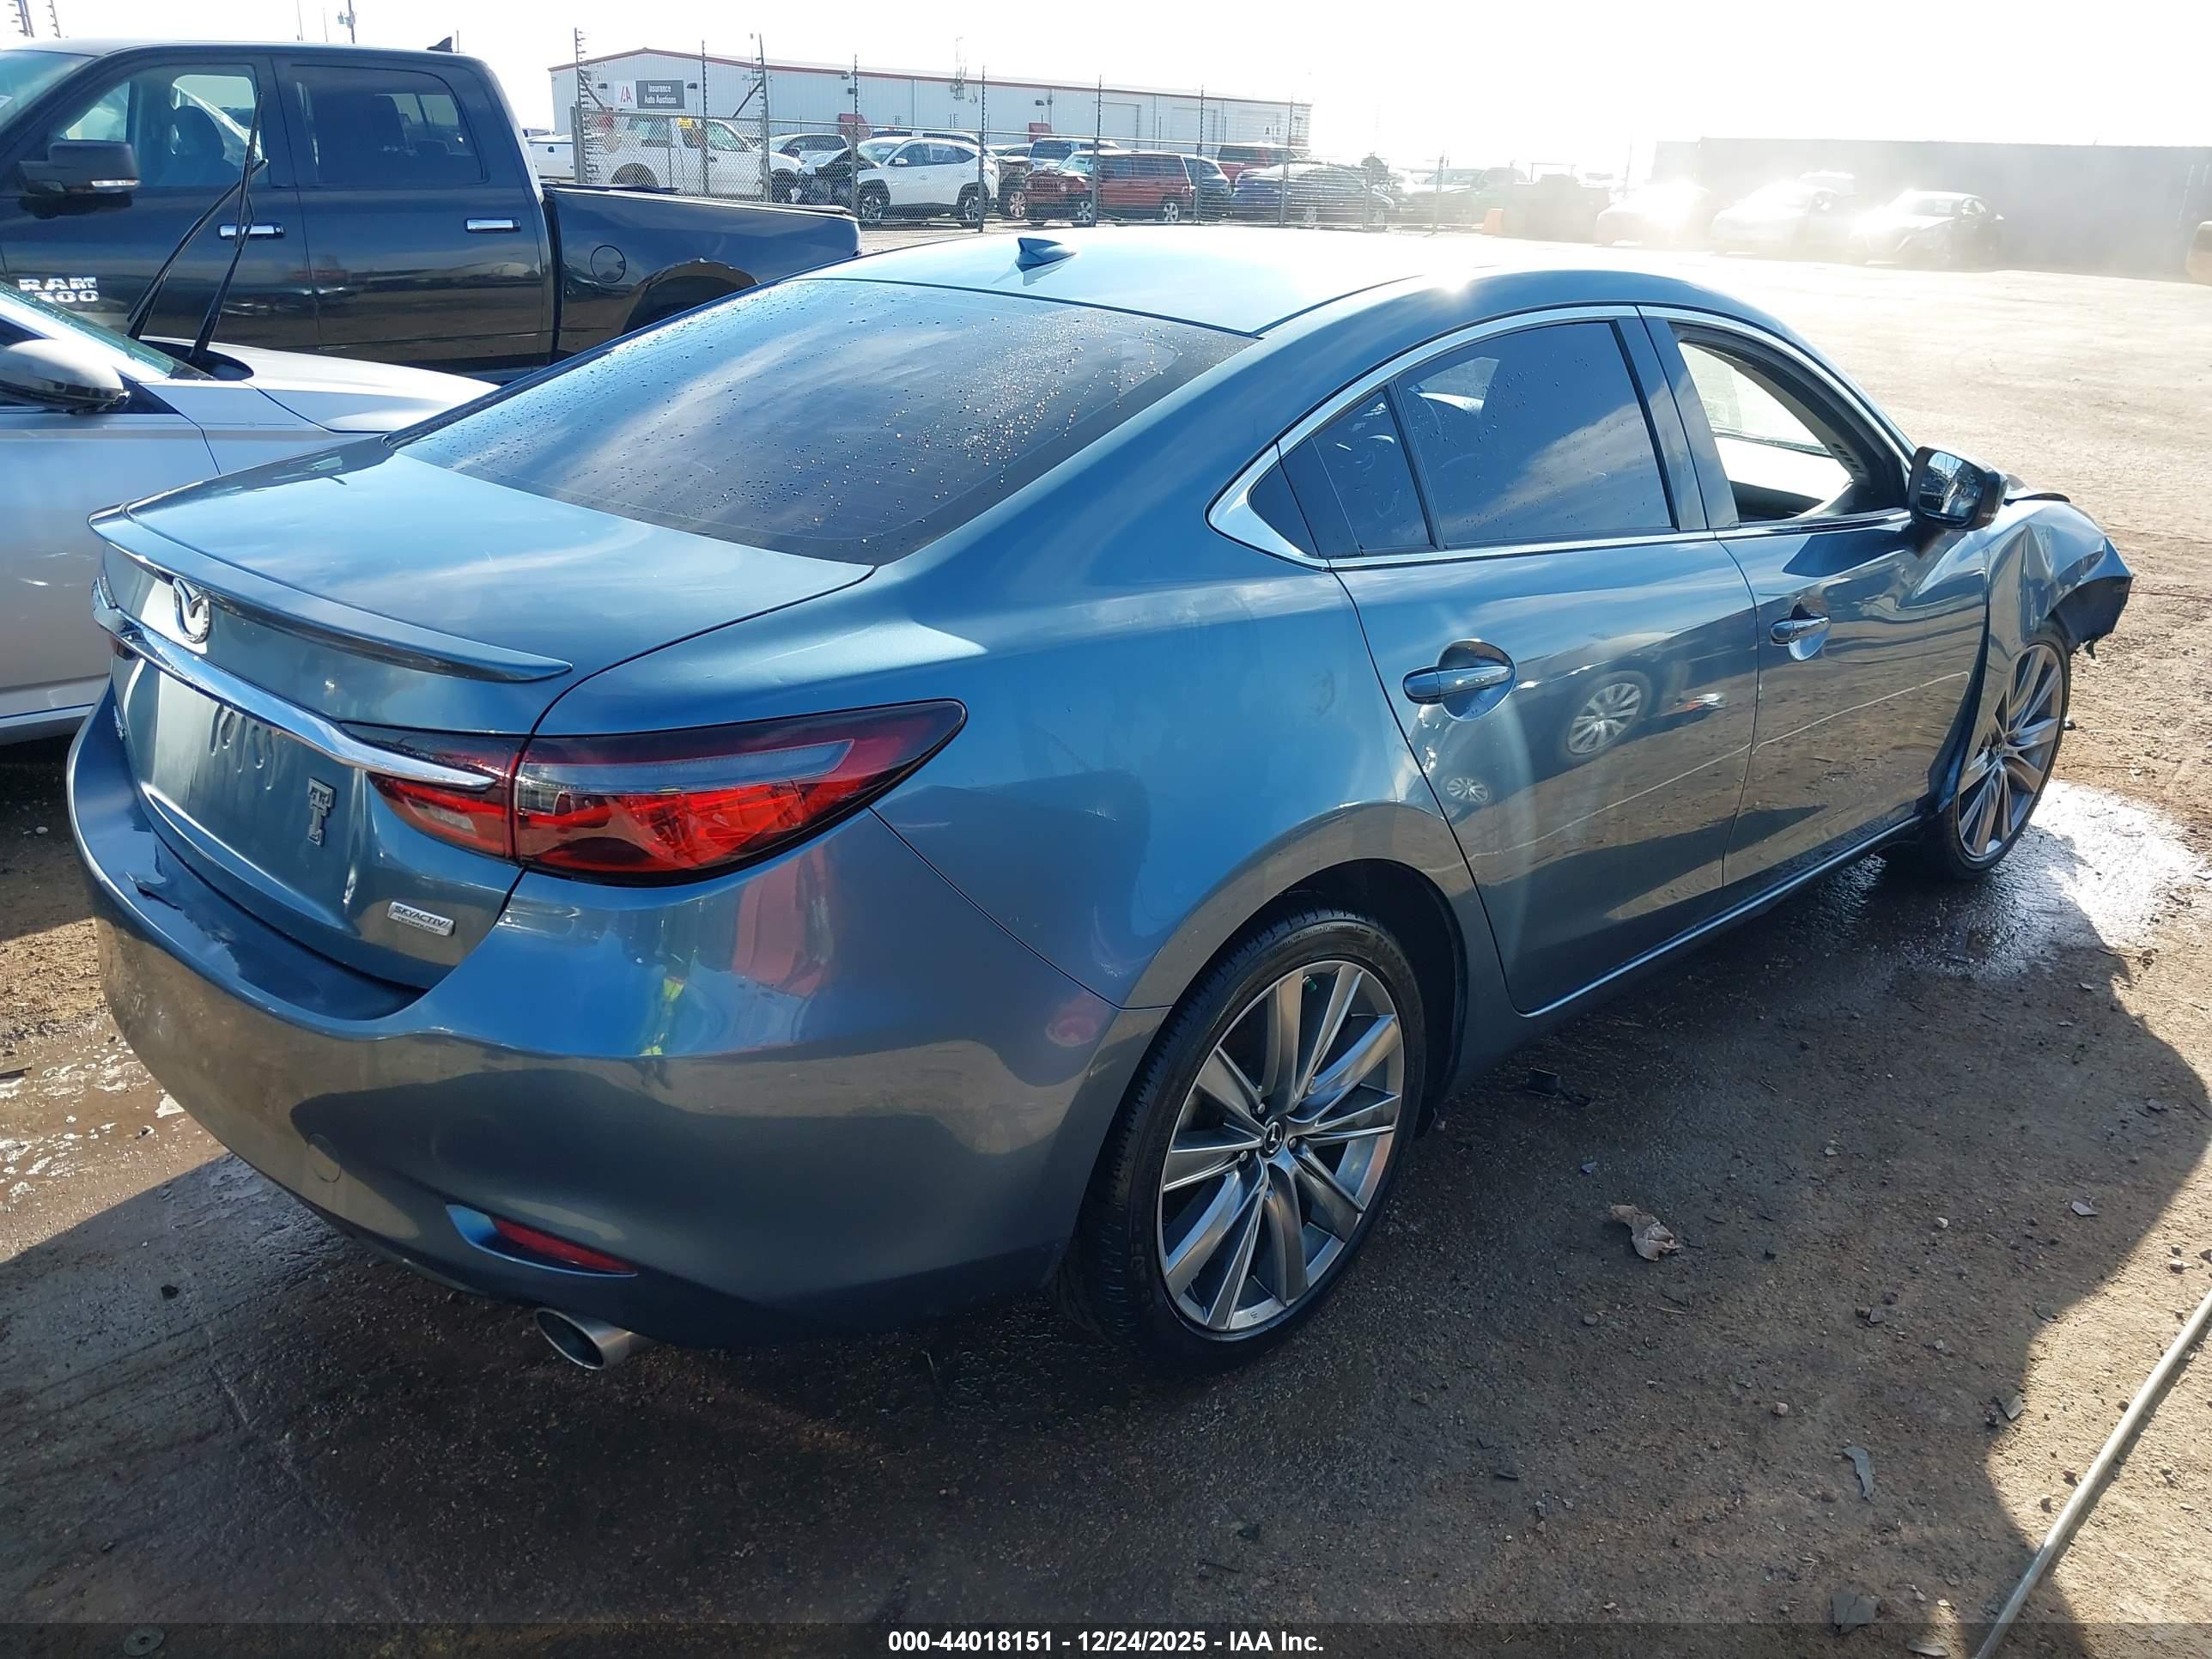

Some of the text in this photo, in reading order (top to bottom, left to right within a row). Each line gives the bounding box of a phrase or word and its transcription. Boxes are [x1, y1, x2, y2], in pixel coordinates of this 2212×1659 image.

[647, 82, 672, 93] Insurance
[644, 94, 677, 104] Auto Auctions
[18, 276, 97, 291] RAM
[393, 905, 447, 927] SKYACTIV
